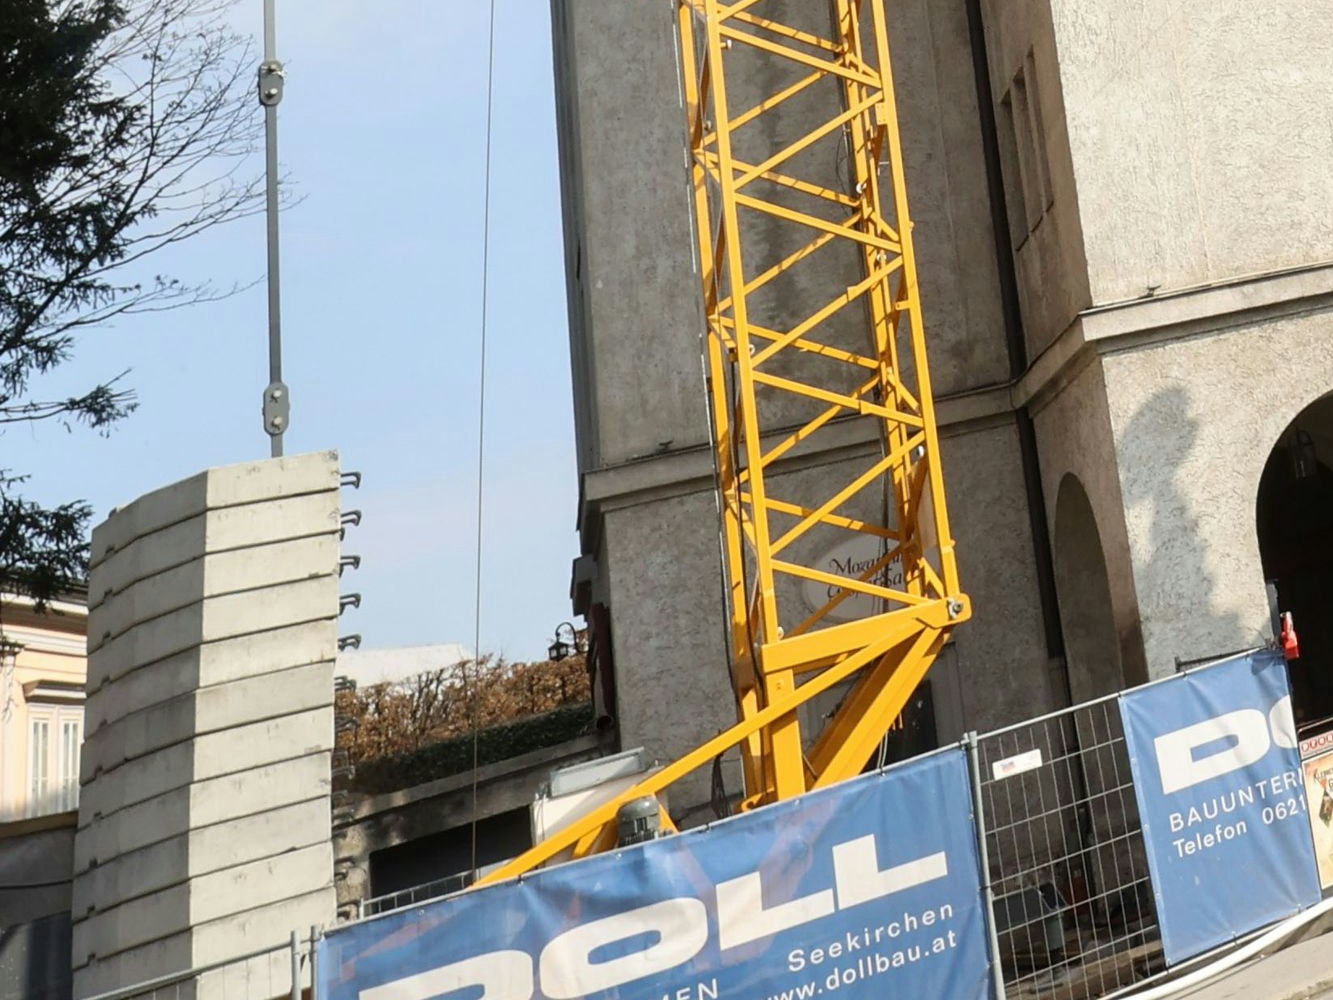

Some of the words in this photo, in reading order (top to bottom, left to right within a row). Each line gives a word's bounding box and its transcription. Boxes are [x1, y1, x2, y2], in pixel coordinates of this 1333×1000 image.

[1154, 694, 1298, 796] D
[1173, 821, 1247, 858] Telefon
[764, 930, 957, 1000] ww.dollbau.at
[787, 904, 953, 972] Seekirchen
